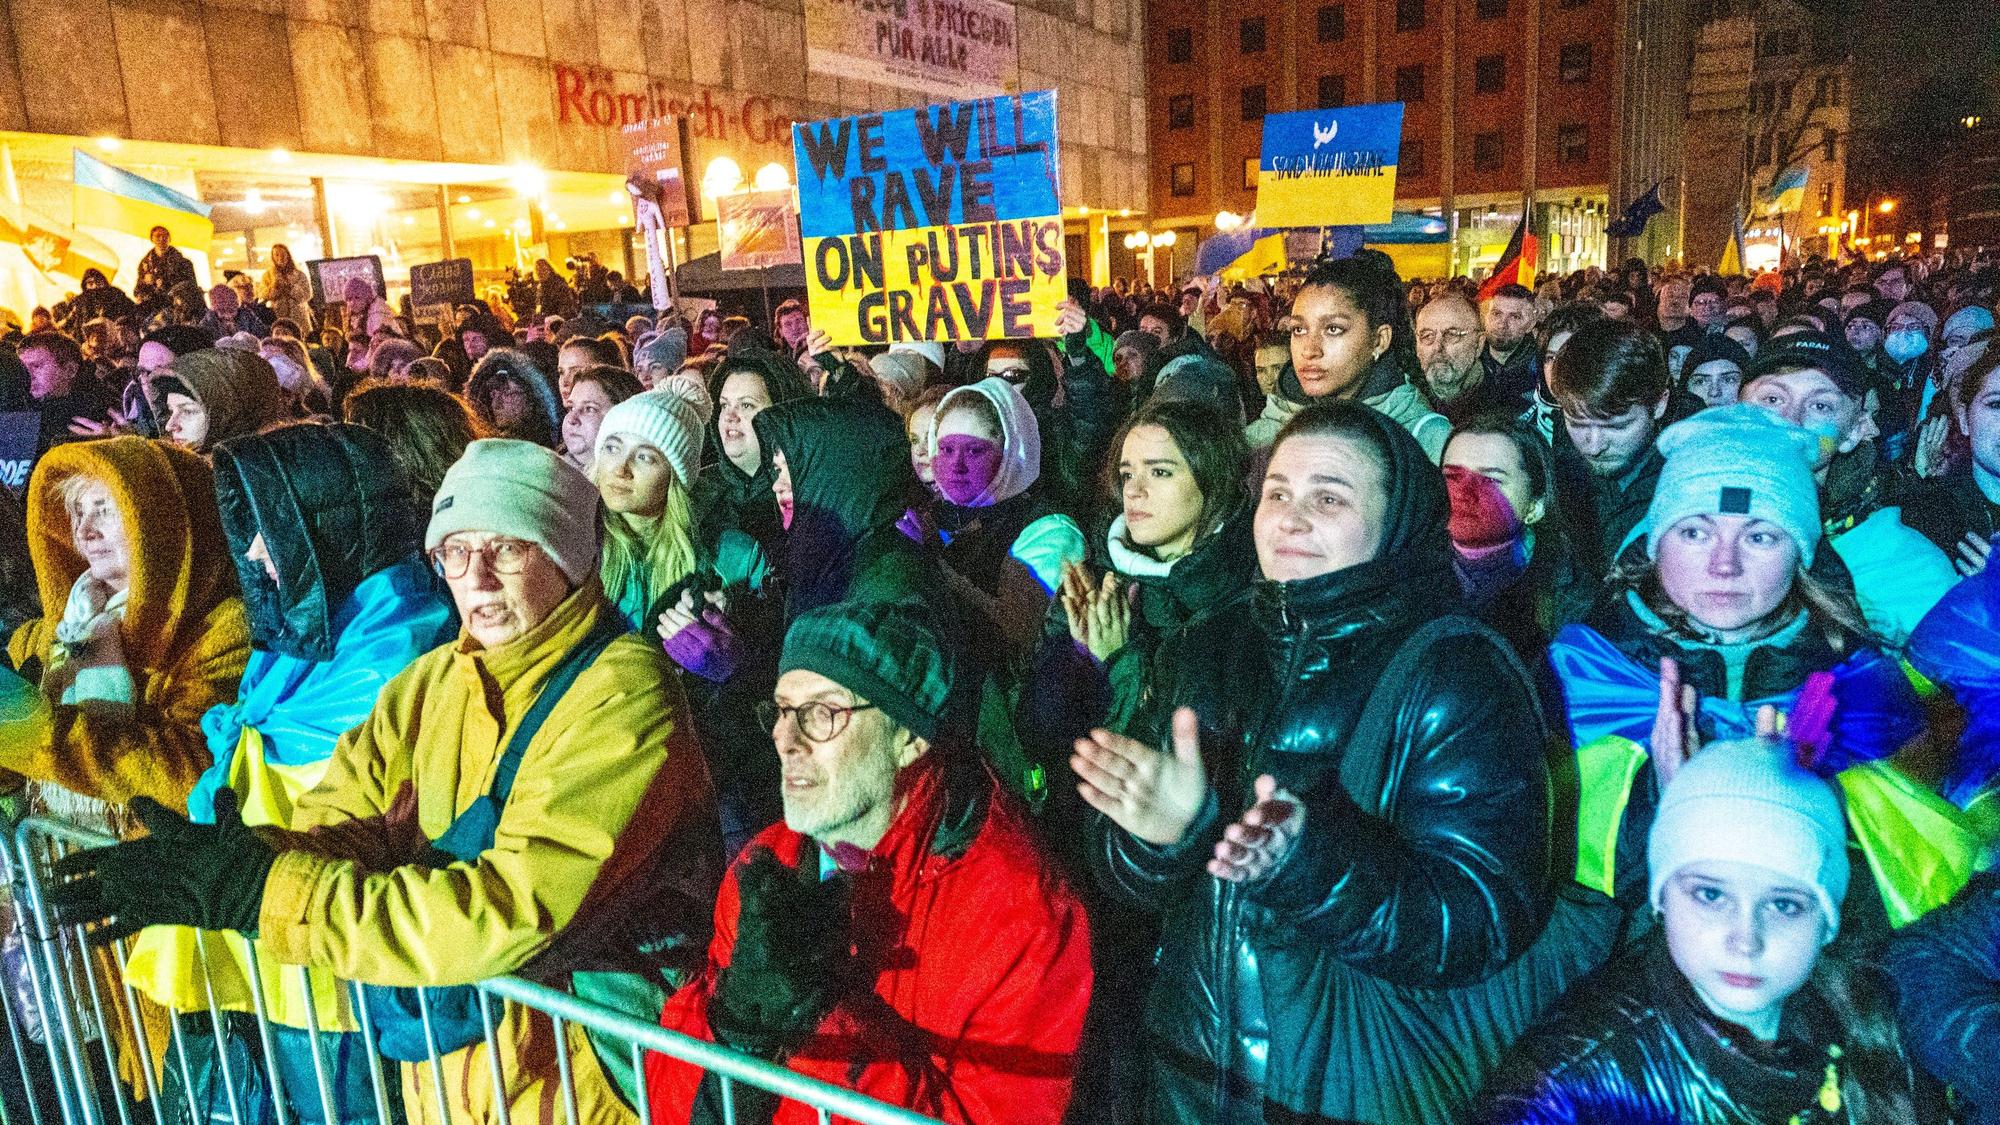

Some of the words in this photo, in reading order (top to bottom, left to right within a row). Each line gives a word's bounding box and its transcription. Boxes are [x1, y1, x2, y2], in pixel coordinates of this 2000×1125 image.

[555, 62, 793, 146] Römisch-Ge
[800, 115, 887, 181] WE
[914, 97, 1047, 167] WILL
[850, 160, 998, 237] RAVE
[815, 233, 884, 293] ON
[906, 219, 1063, 286] PUTIN'S
[857, 278, 1035, 343] GRAVE
